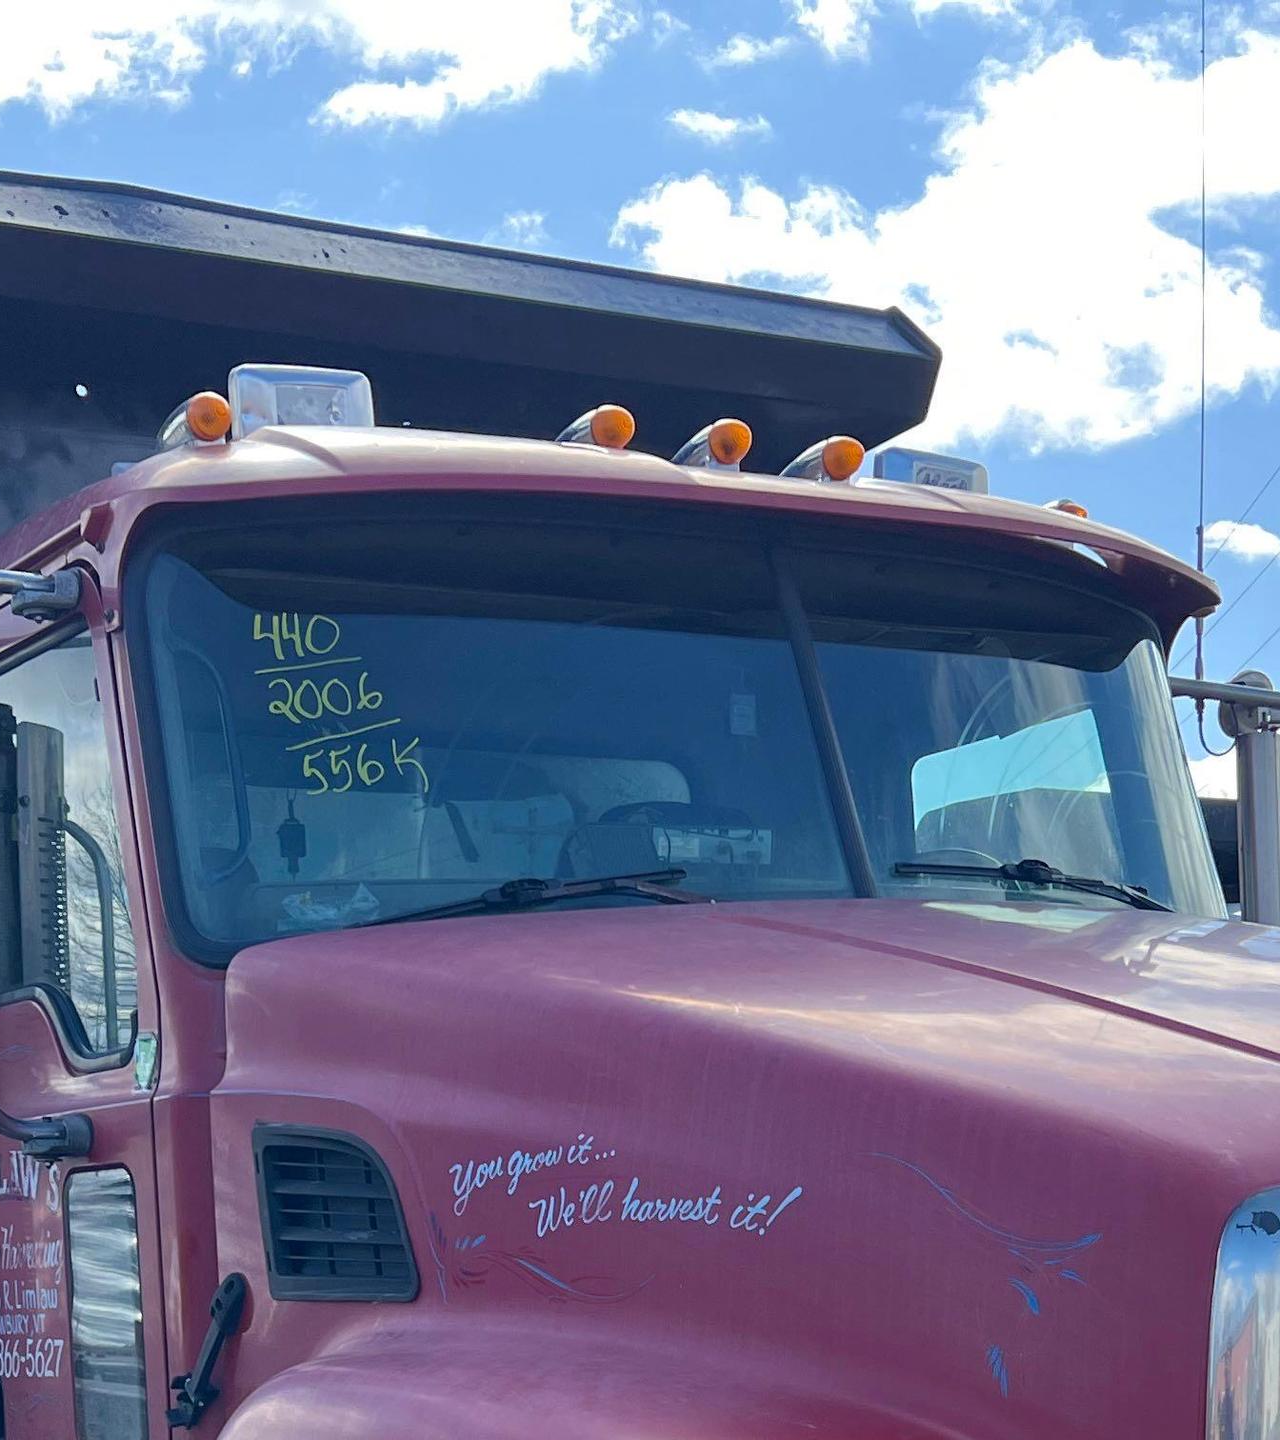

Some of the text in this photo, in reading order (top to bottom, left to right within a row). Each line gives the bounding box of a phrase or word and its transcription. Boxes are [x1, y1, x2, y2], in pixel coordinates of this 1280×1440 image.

[253, 612, 340, 660] 440
[268, 672, 383, 724] 2006
[449, 1160, 504, 1216] You
[507, 1148, 563, 1195] grow
[528, 1176, 803, 1238] We'll harvest it!
[15, 1278, 58, 1310] Limlaw
